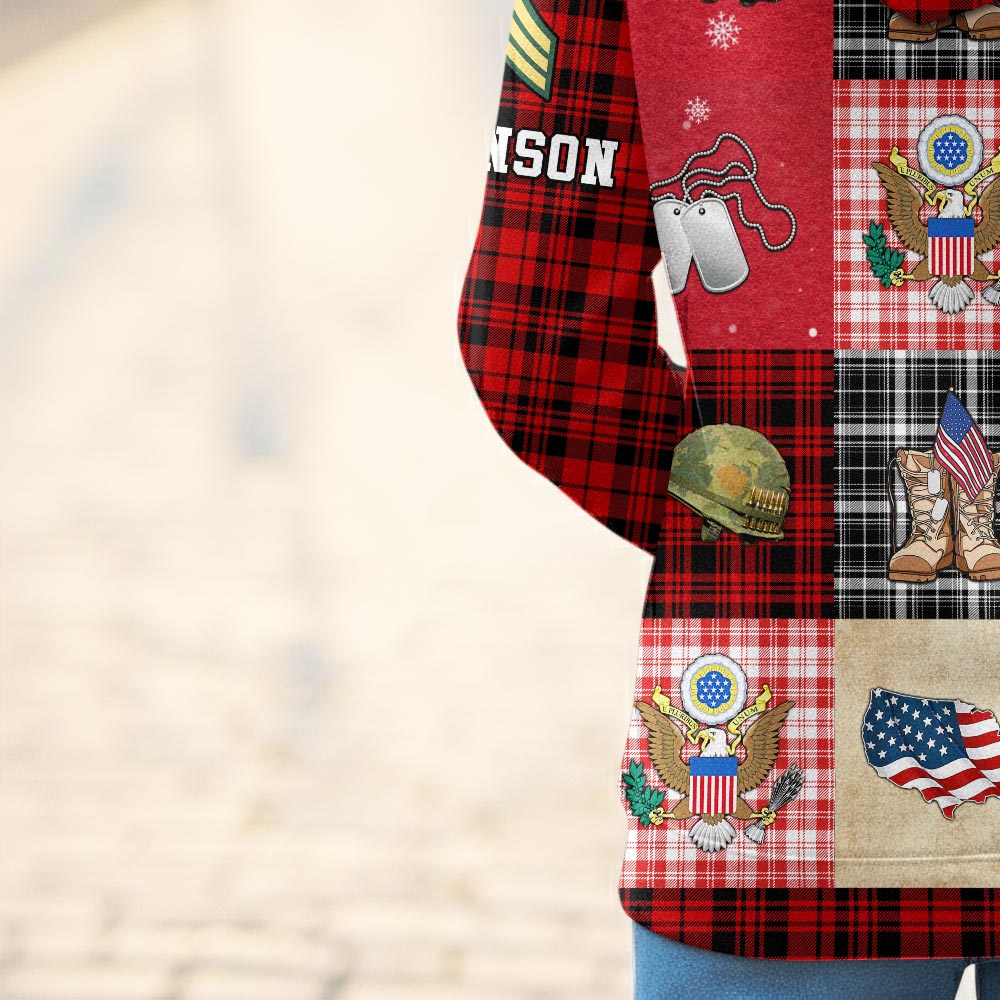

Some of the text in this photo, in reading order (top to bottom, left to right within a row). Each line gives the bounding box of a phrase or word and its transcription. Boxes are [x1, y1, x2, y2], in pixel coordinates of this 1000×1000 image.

[969, 167, 994, 187] UNUM
[669, 707, 697, 730] PLURIBUS
[732, 706, 758, 726] UNUM
